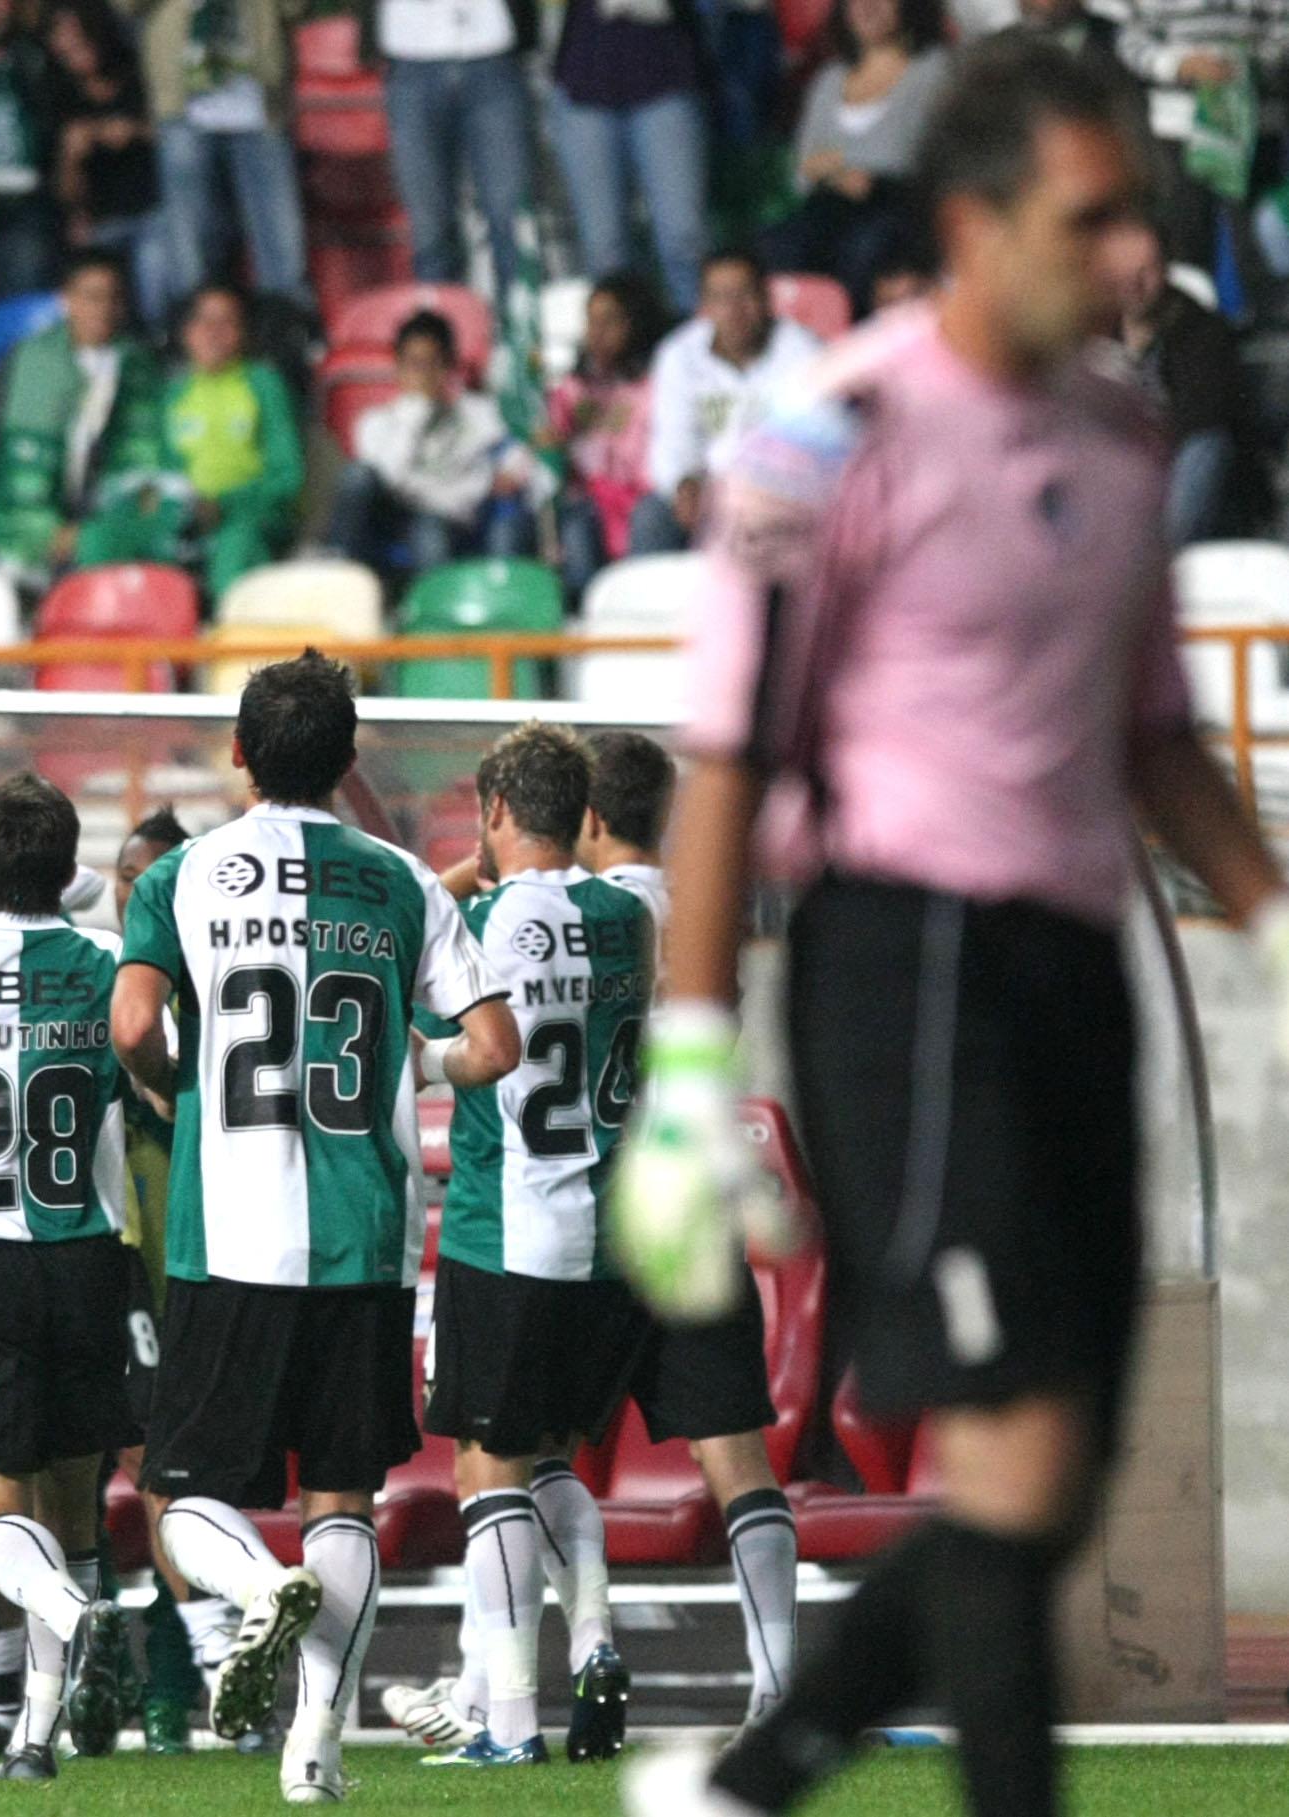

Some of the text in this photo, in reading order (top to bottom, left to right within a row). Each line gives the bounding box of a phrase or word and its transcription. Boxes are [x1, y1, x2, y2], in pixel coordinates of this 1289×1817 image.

[277, 857, 390, 906] BES
[208, 917, 397, 960] H.POSTIGA
[218, 963, 387, 1137] 23
